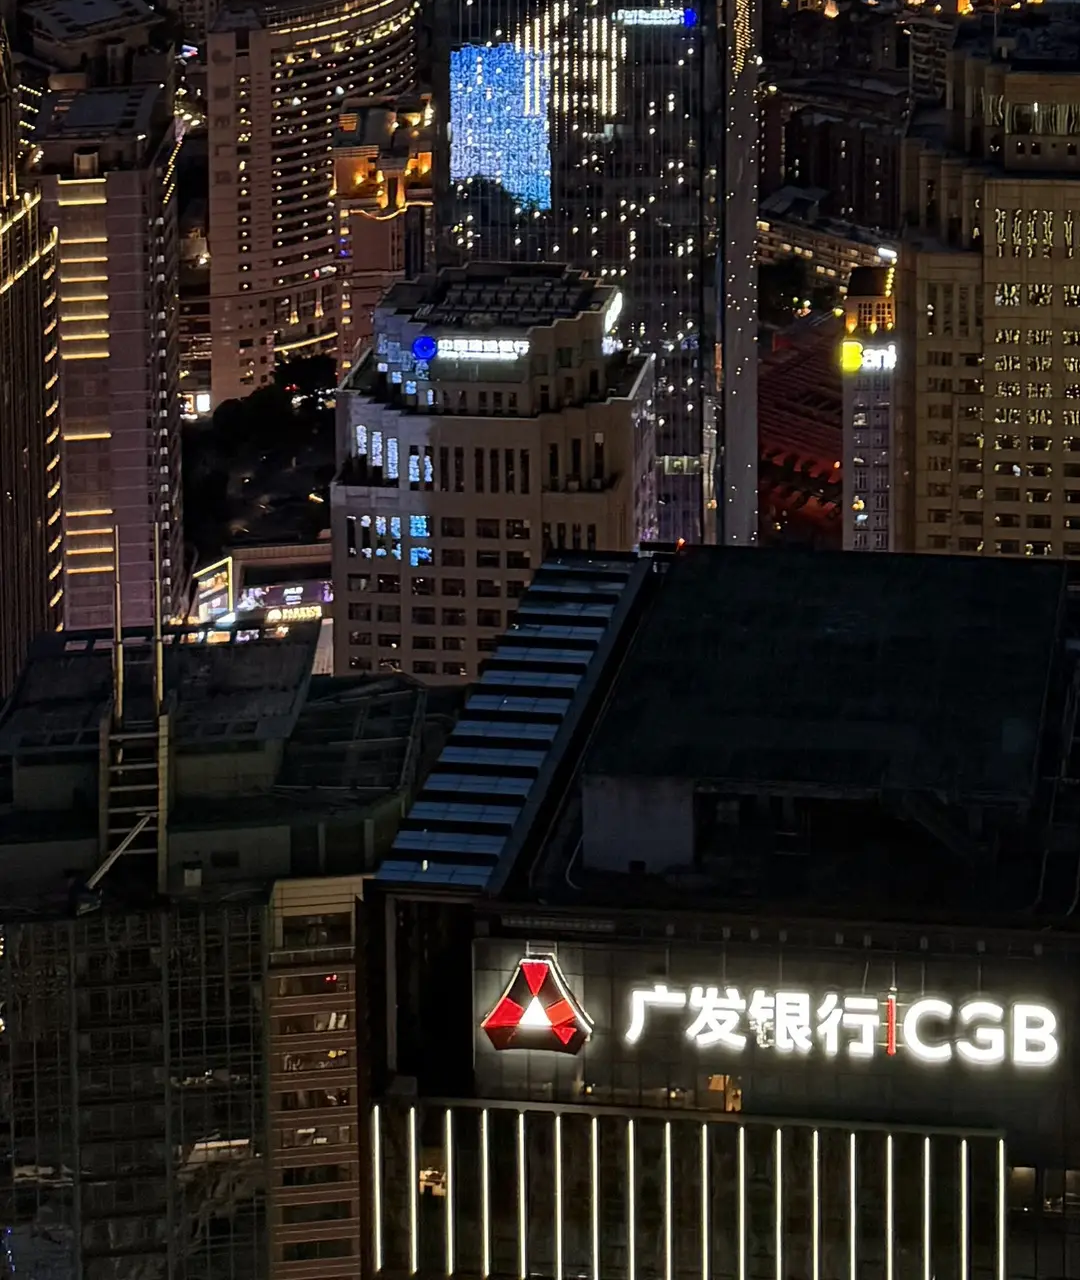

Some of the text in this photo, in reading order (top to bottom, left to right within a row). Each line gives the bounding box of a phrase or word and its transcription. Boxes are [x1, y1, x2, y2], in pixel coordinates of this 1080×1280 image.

[625, 985, 1059, 1064] 广发银行 CGB
